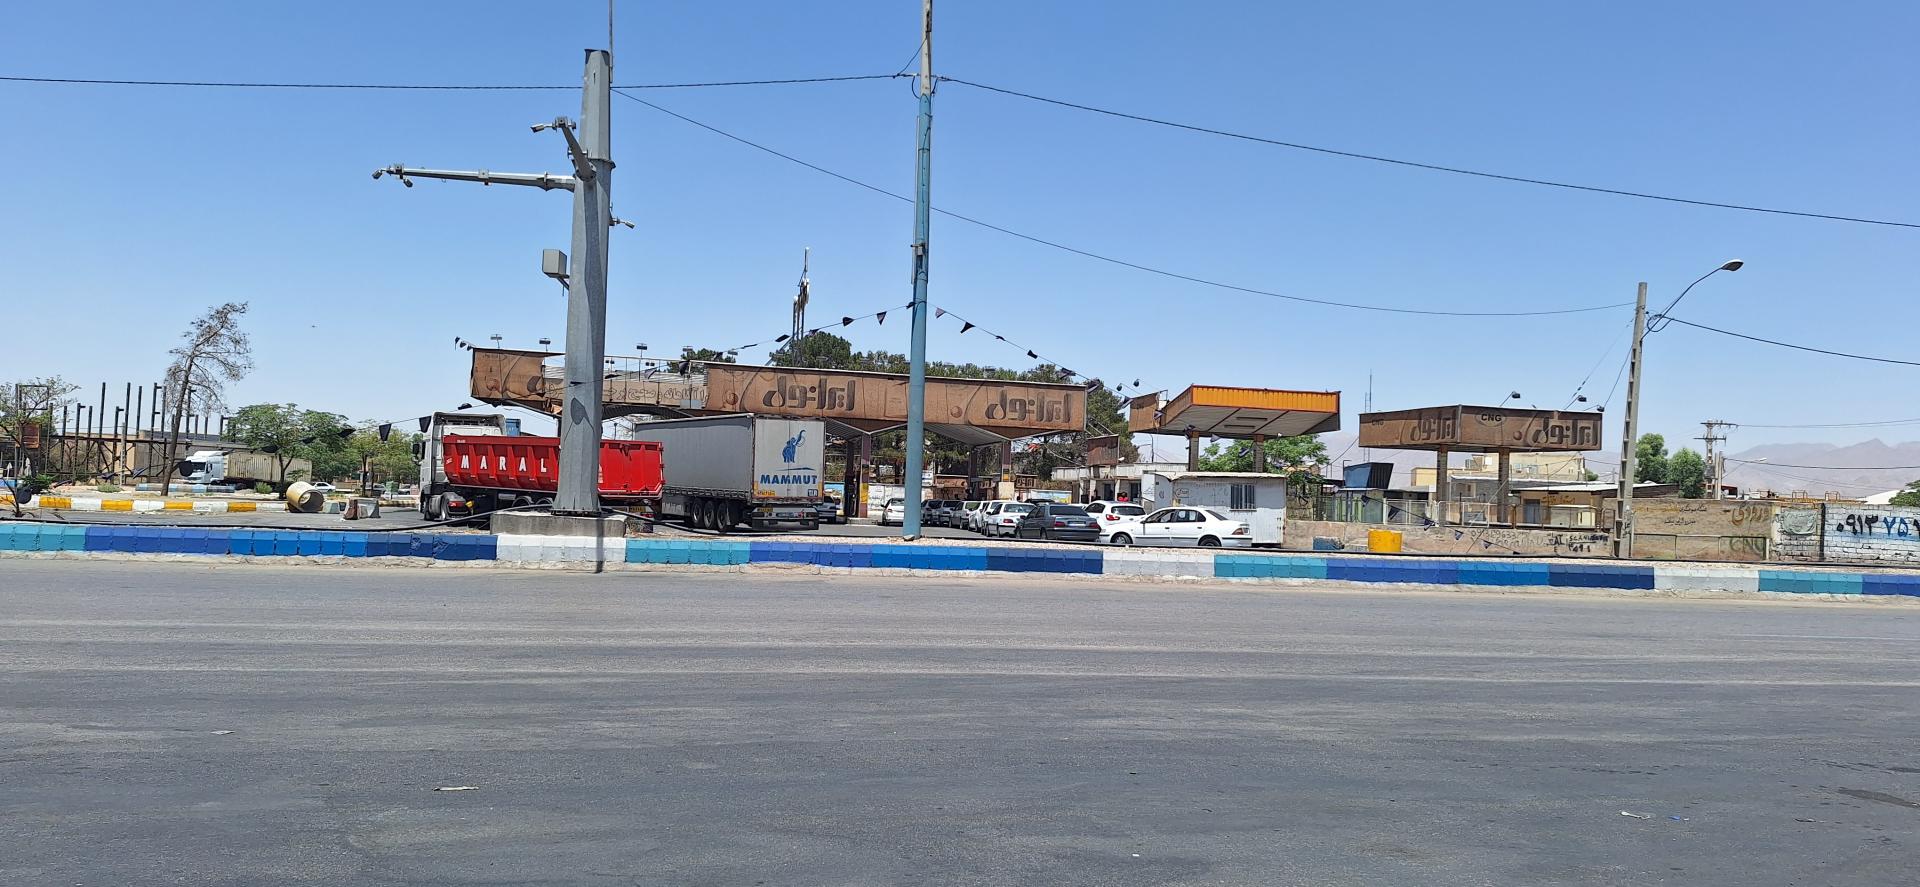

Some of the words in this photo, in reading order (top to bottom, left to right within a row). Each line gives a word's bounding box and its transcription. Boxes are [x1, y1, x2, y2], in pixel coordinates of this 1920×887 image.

[763, 375, 856, 412] ایرانول
[985, 389, 1073, 424] ایرانول
[1410, 408, 1457, 441] ایرانول
[1480, 413, 1502, 423] CNG
[1531, 416, 1599, 447] ایرانول
[460, 454, 547, 473] MARAL
[760, 474, 818, 485] MAMMUT
